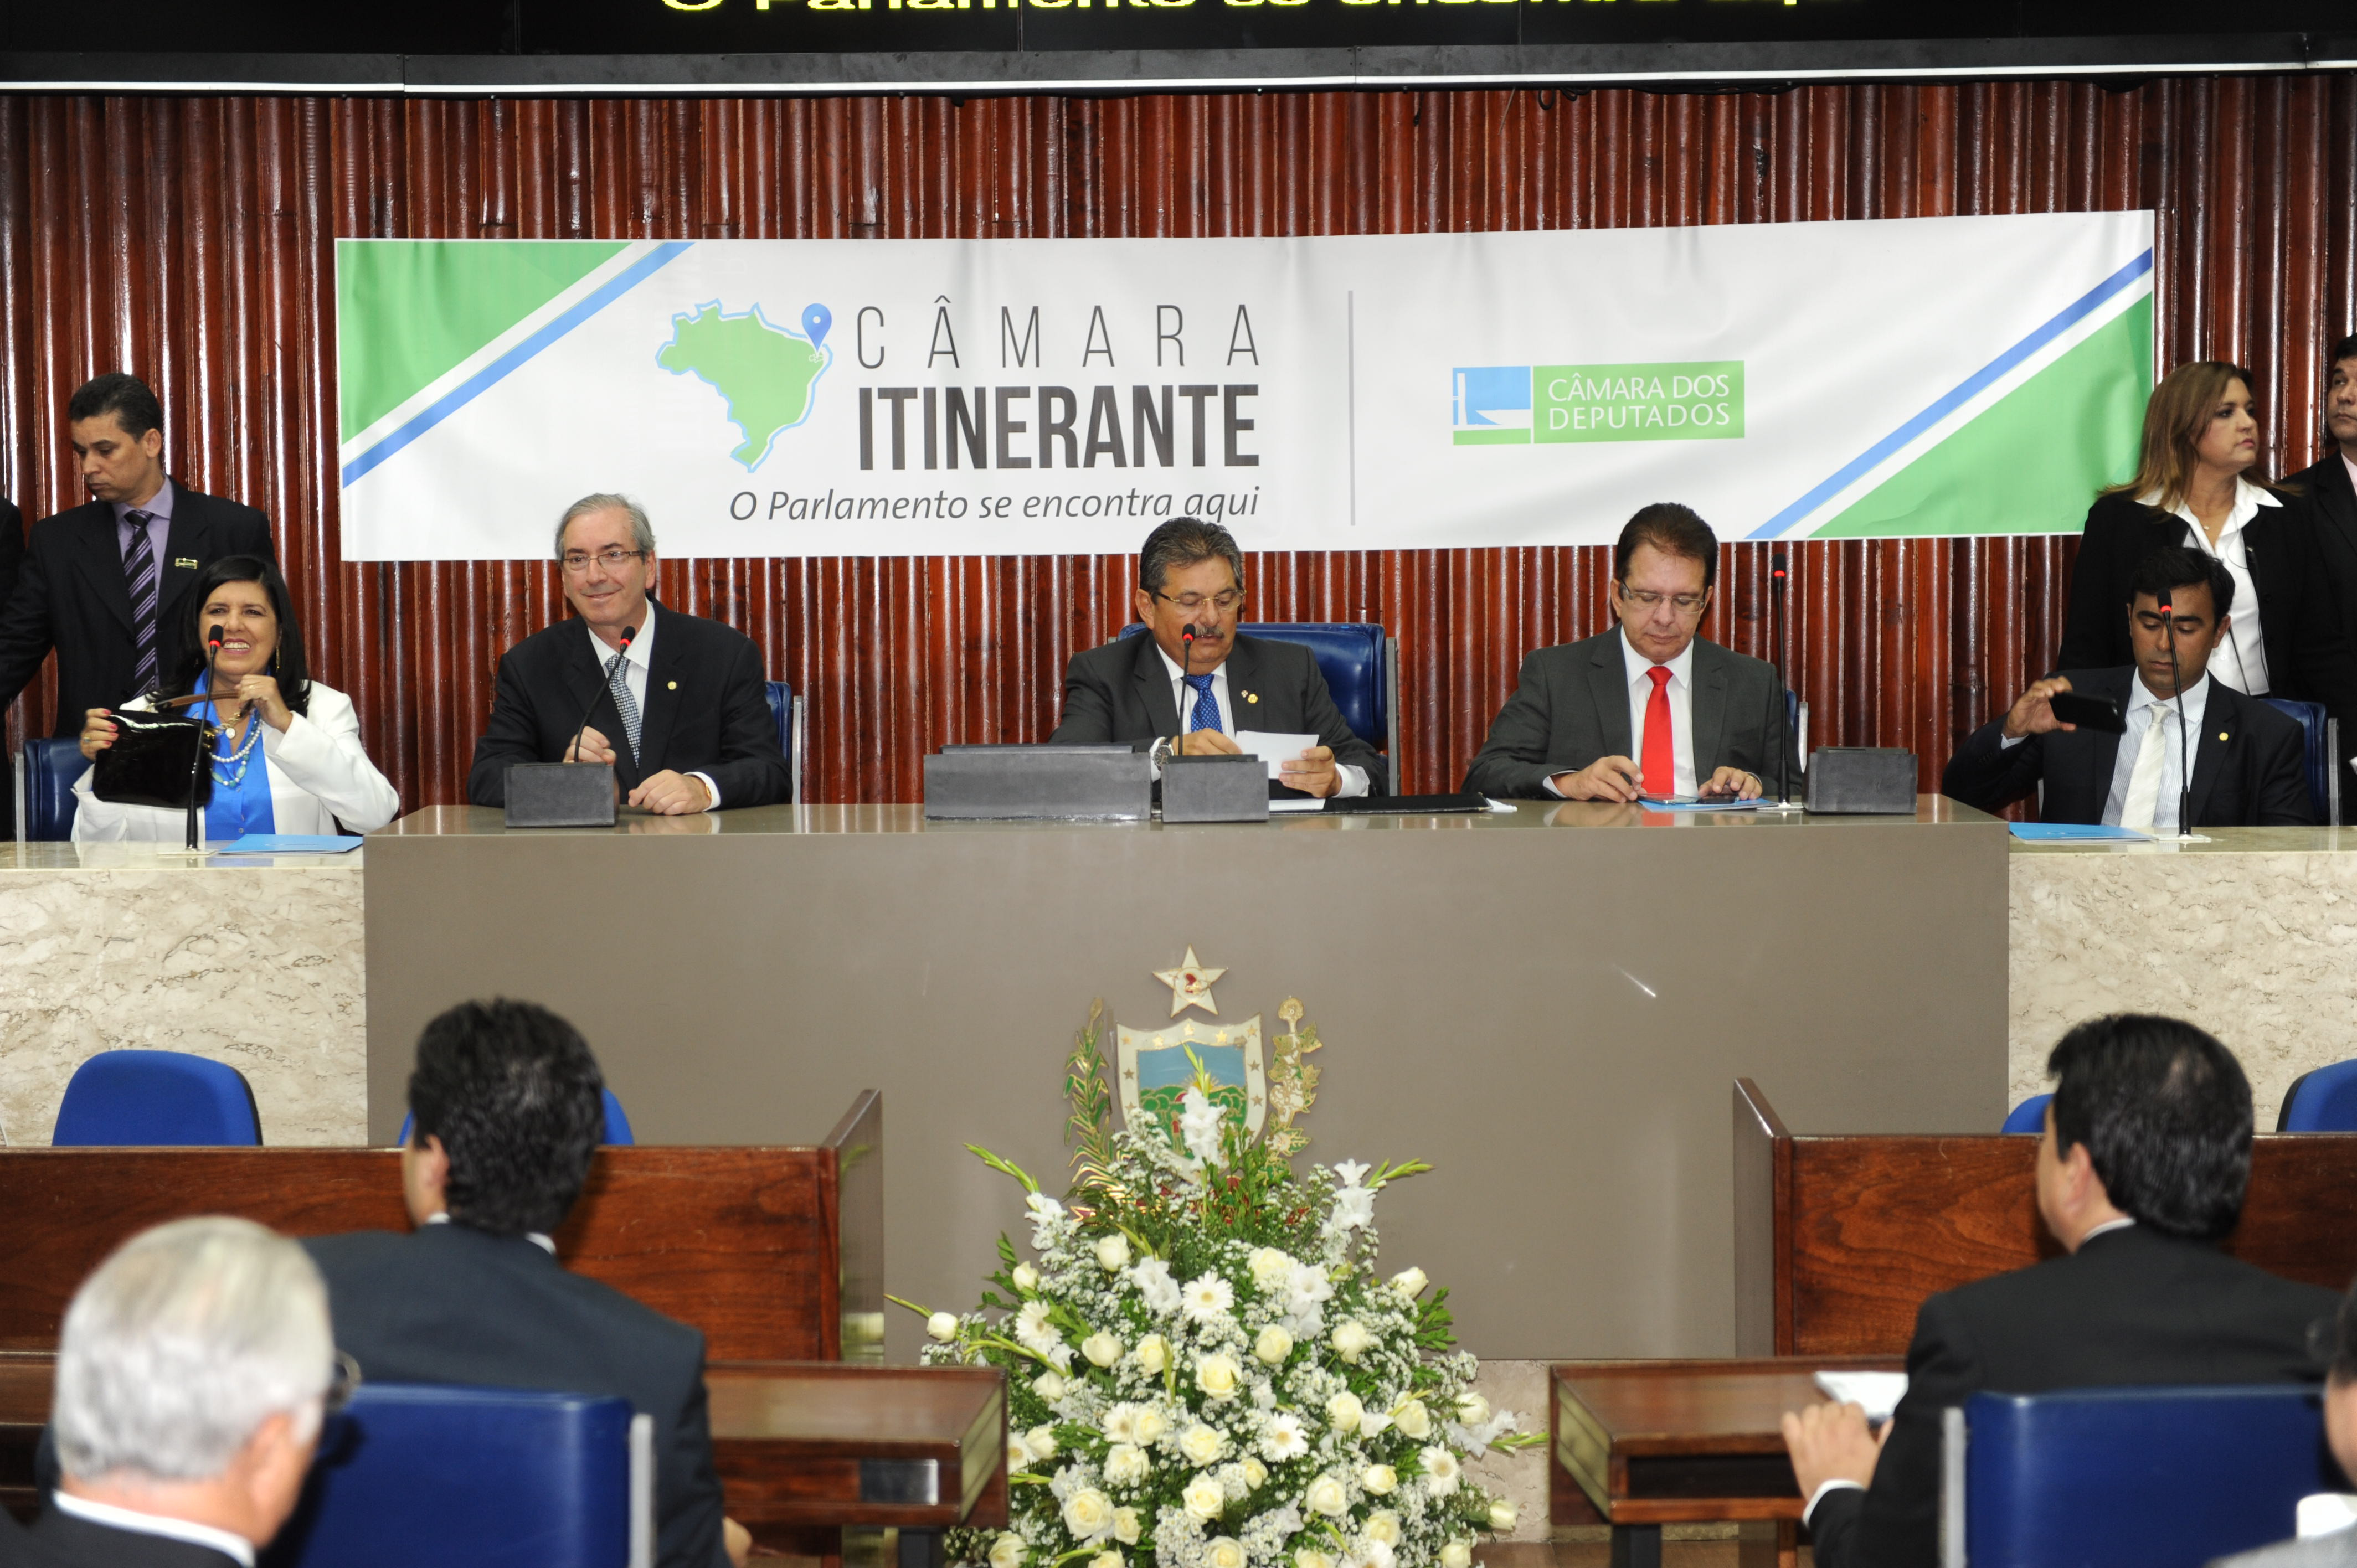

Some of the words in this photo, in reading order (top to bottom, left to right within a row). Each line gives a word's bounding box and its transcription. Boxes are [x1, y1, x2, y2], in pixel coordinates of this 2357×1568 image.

[857, 295, 1259, 369] CÂMARA
[1548, 373, 1665, 402] CÂMARA
[1673, 374, 1730, 399] DOS
[859, 384, 1259, 470] ITINERANTE
[1549, 403, 1730, 430] DEPUTADOS
[729, 491, 757, 520] O
[768, 488, 968, 520] Parlamento
[979, 496, 1012, 518] se
[1023, 487, 1173, 518] encontra
[1184, 486, 1260, 523] aqui
